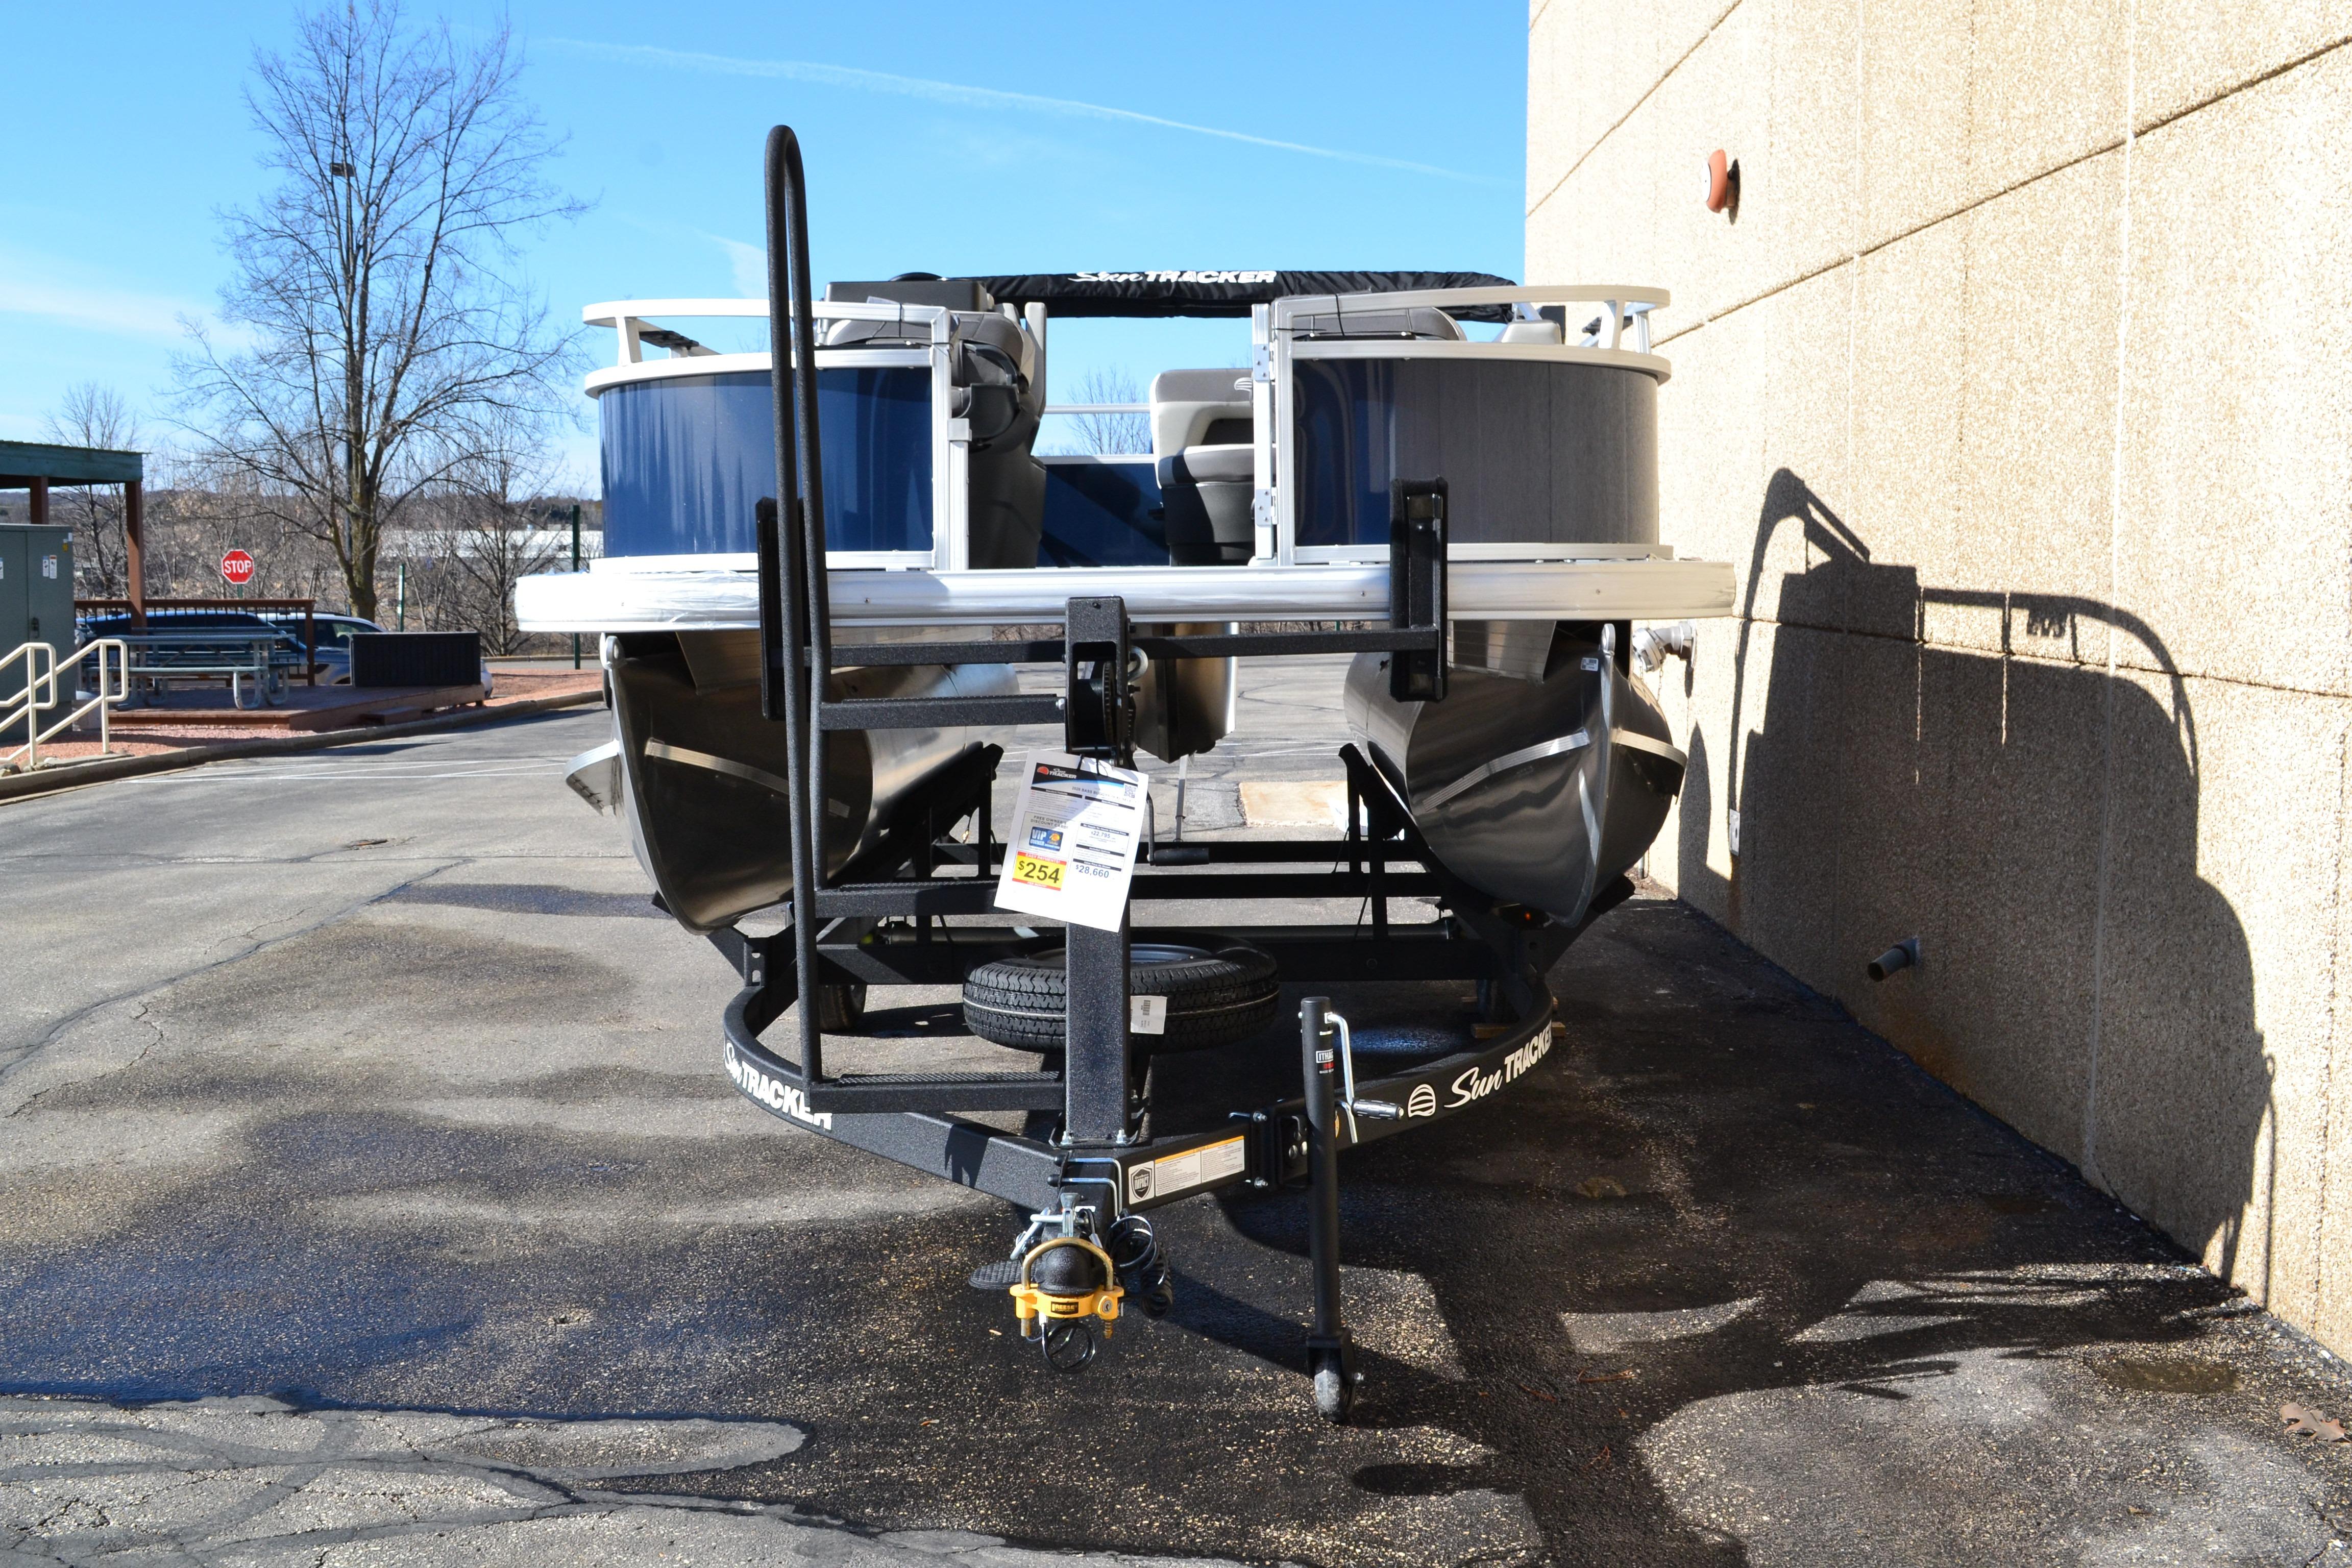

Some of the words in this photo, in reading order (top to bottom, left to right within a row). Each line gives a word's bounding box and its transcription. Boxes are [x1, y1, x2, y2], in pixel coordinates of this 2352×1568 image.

[1067, 271, 1143, 283] Sun
[1144, 270, 1277, 284] TRACKER
[224, 560, 252, 573] STOP
[1049, 771, 1077, 779] TRACKER
[1032, 829, 1047, 841] VIP
[1018, 861, 1060, 884] $254
[1075, 864, 1109, 878] $28,660
[725, 1042, 742, 1084] Sun
[1444, 1066, 1503, 1108] Sun
